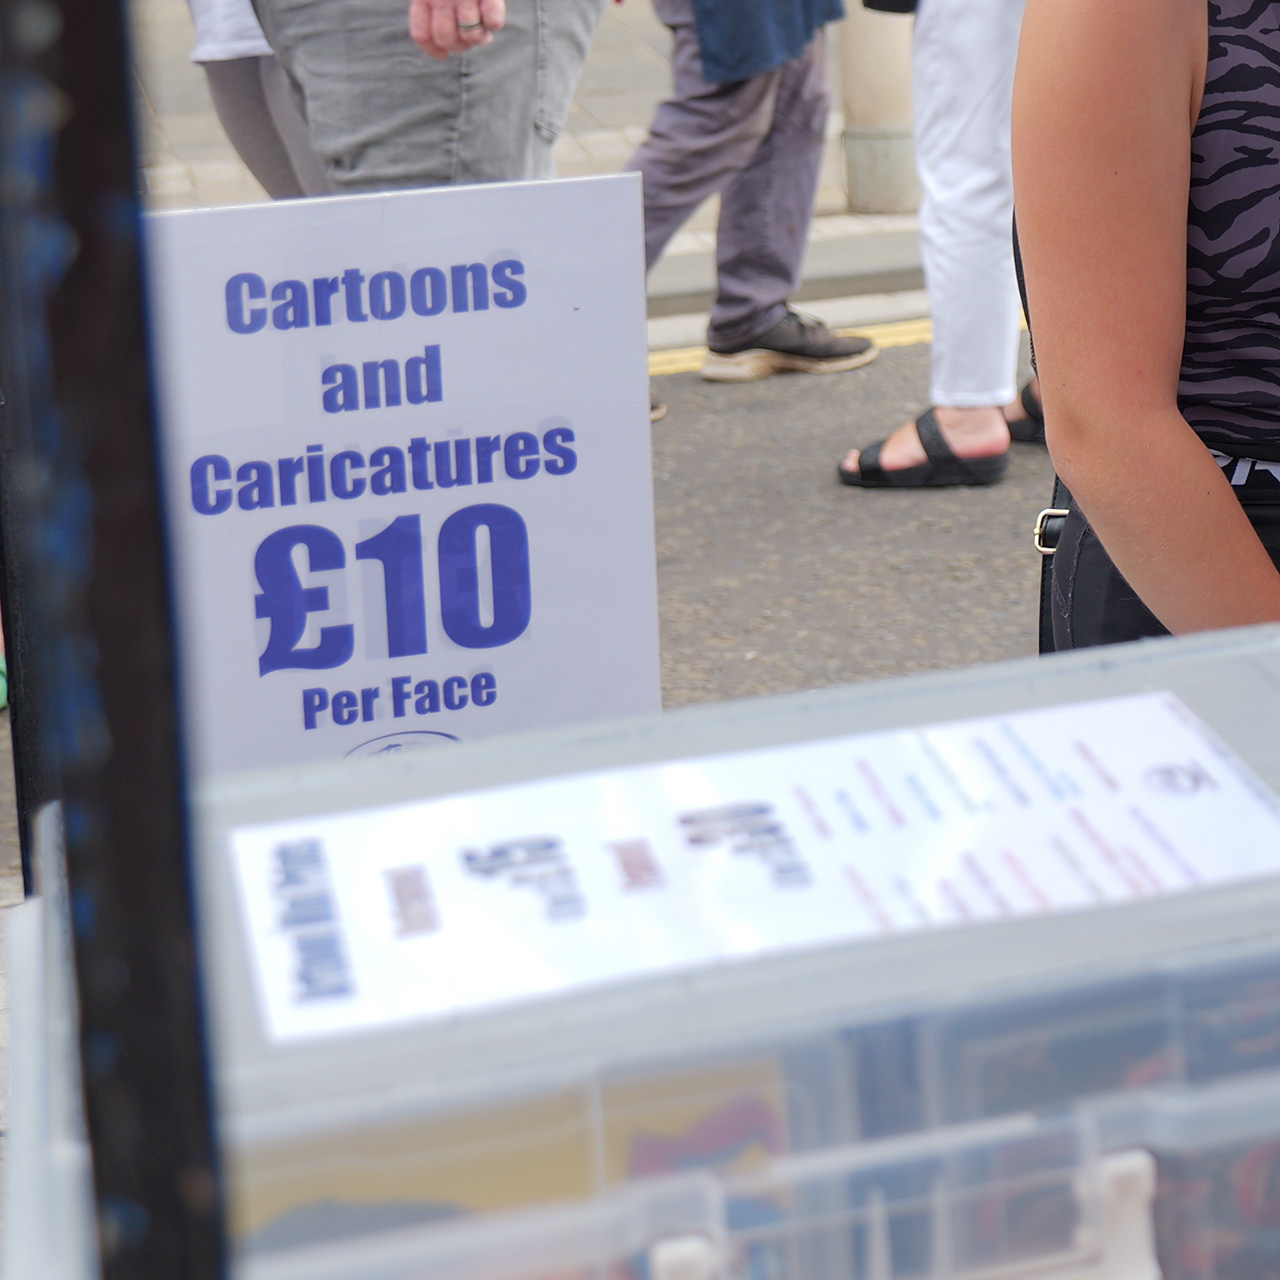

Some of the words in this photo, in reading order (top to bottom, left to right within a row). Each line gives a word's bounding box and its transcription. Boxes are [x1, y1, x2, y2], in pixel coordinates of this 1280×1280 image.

[225, 259, 528, 335] Cartoons
[321, 344, 444, 415] and
[190, 425, 578, 516] Caricatures
[253, 502, 533, 679] £10
[302, 682, 380, 730] Per
[390, 670, 498, 719] Face
